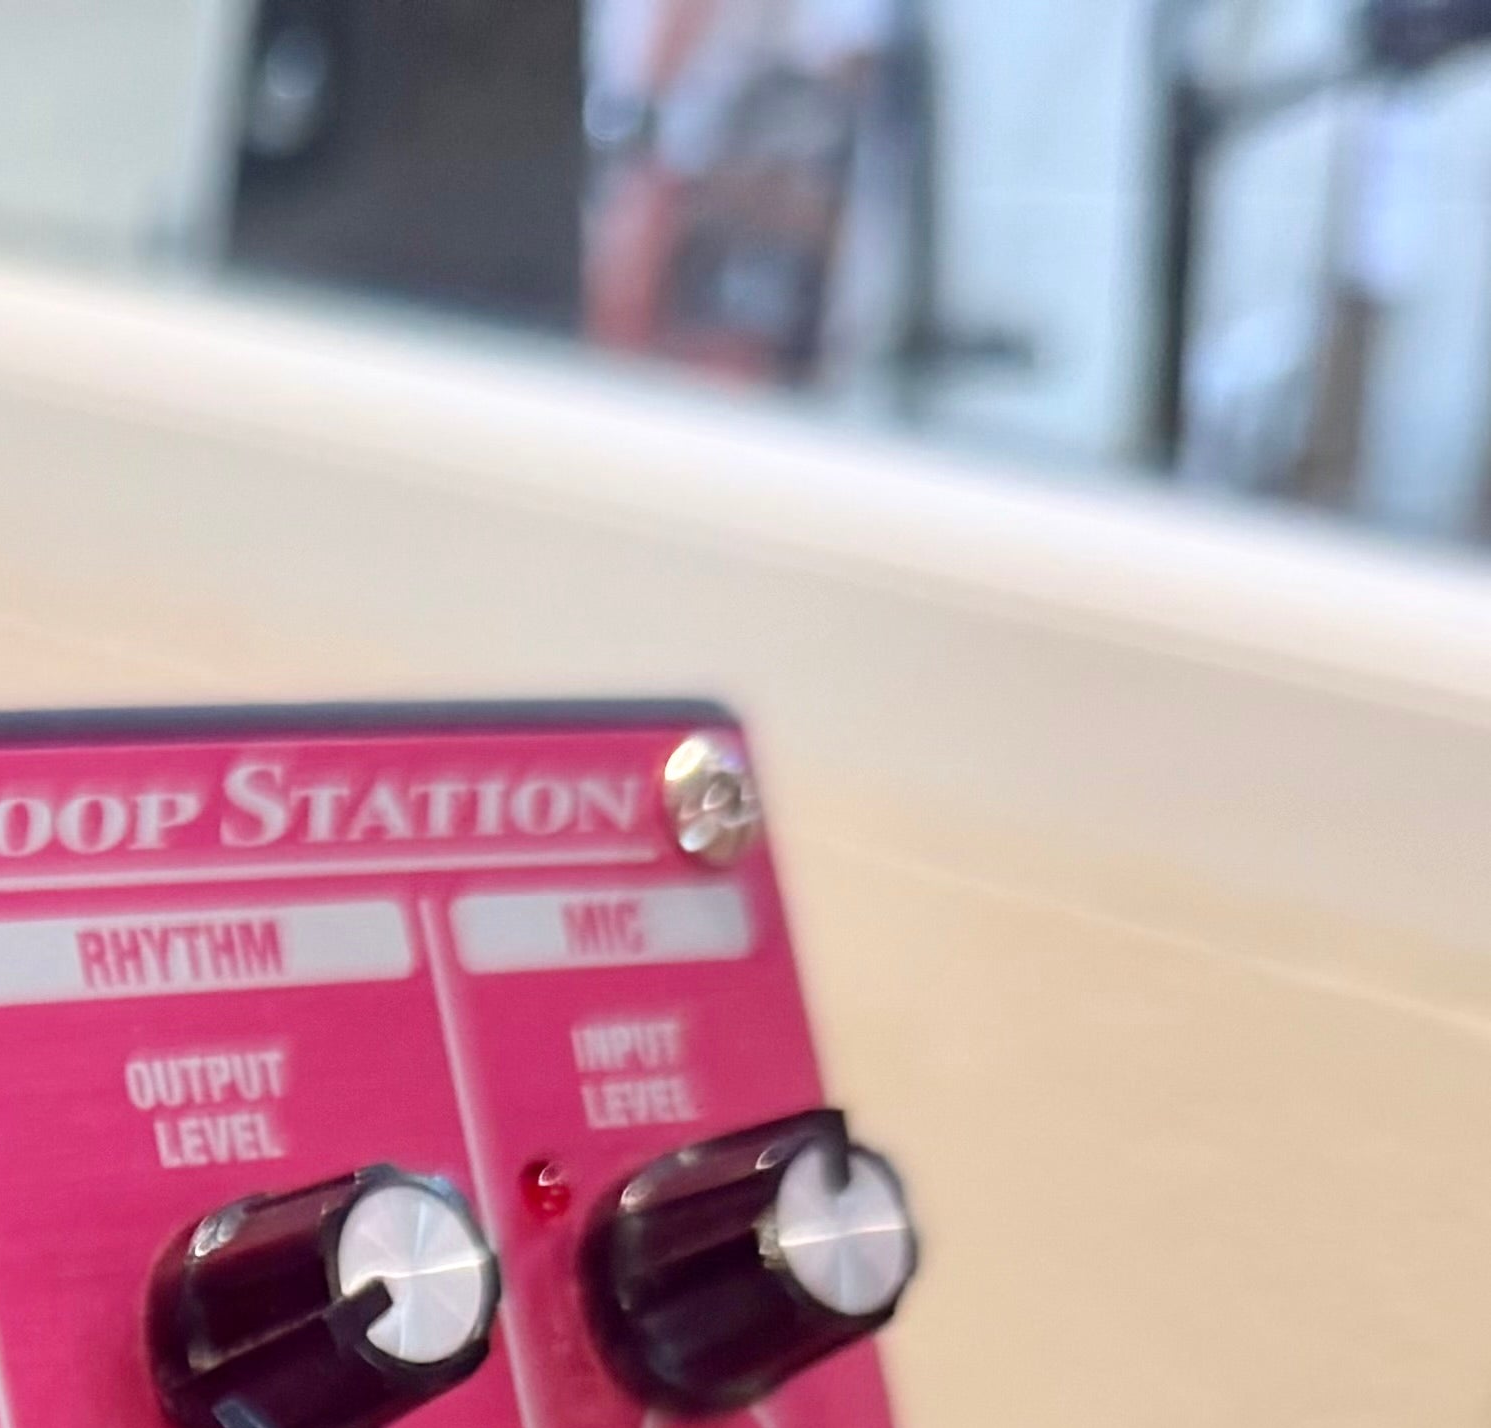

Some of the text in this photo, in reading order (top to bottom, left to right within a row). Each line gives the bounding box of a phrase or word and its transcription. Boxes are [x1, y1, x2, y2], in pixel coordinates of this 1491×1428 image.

[76, 918, 285, 990] RHYTHM
[564, 899, 642, 959] MIC
[573, 1021, 685, 1074] INPUT
[126, 1048, 286, 1109] OUTPUT
[582, 1077, 700, 1129] LEVEL
[156, 1118, 287, 1169] LEVEL
